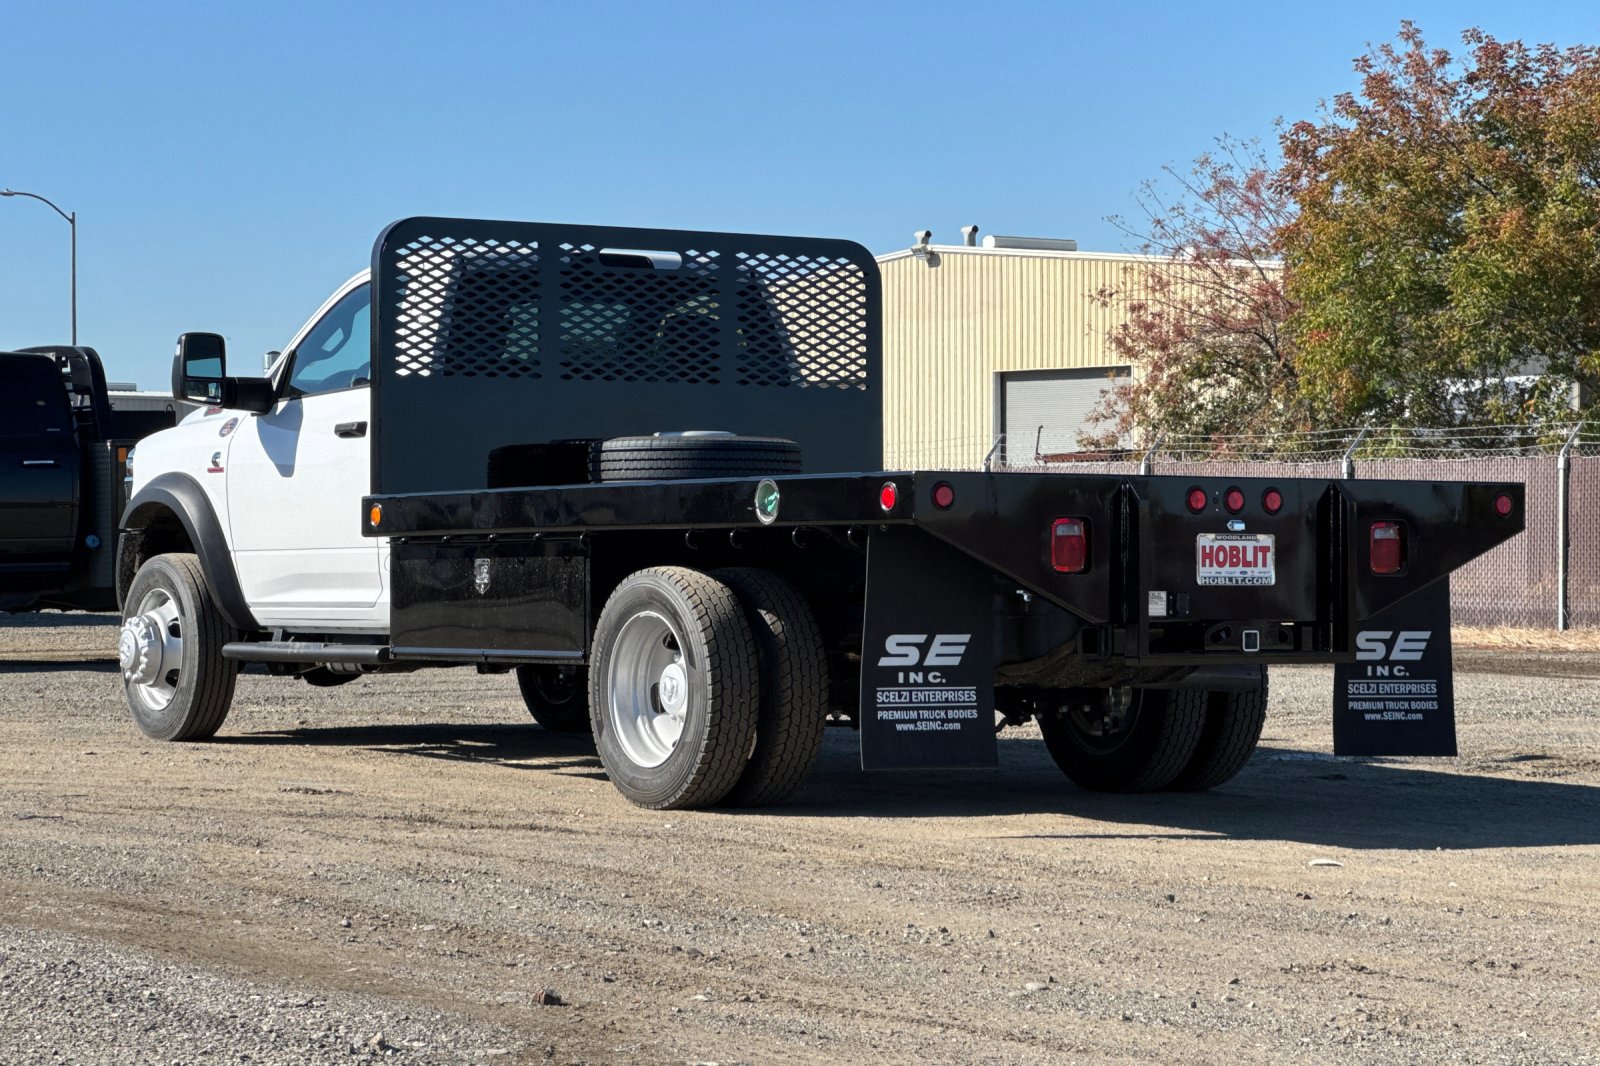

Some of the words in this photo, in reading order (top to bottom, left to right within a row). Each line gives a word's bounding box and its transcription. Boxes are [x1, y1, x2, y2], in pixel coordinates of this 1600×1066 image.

[1201, 545, 1271, 568] HOBLIT
[1201, 577, 1271, 585] HOBLIT.COM
[878, 634, 971, 666] SE
[1356, 631, 1432, 660] SE
[1367, 665, 1410, 676] INC.
[898, 671, 946, 683] INC.
[1348, 683, 1377, 694] SCELZI
[1379, 683, 1437, 694] ENTERPRISES
[876, 691, 909, 702] SCELZI
[912, 691, 976, 702] ENTERPRISES
[1348, 701, 1384, 710] PREMIUM
[1385, 701, 1410, 709] TRUCK
[1411, 701, 1438, 709] BODIES
[877, 710, 918, 720] PREMIUM
[919, 710, 947, 719] TRUCK
[948, 709, 978, 718] BODIES
[1364, 711, 1423, 720] www.SEINC.com
[895, 721, 961, 731] www.SEINC.com
